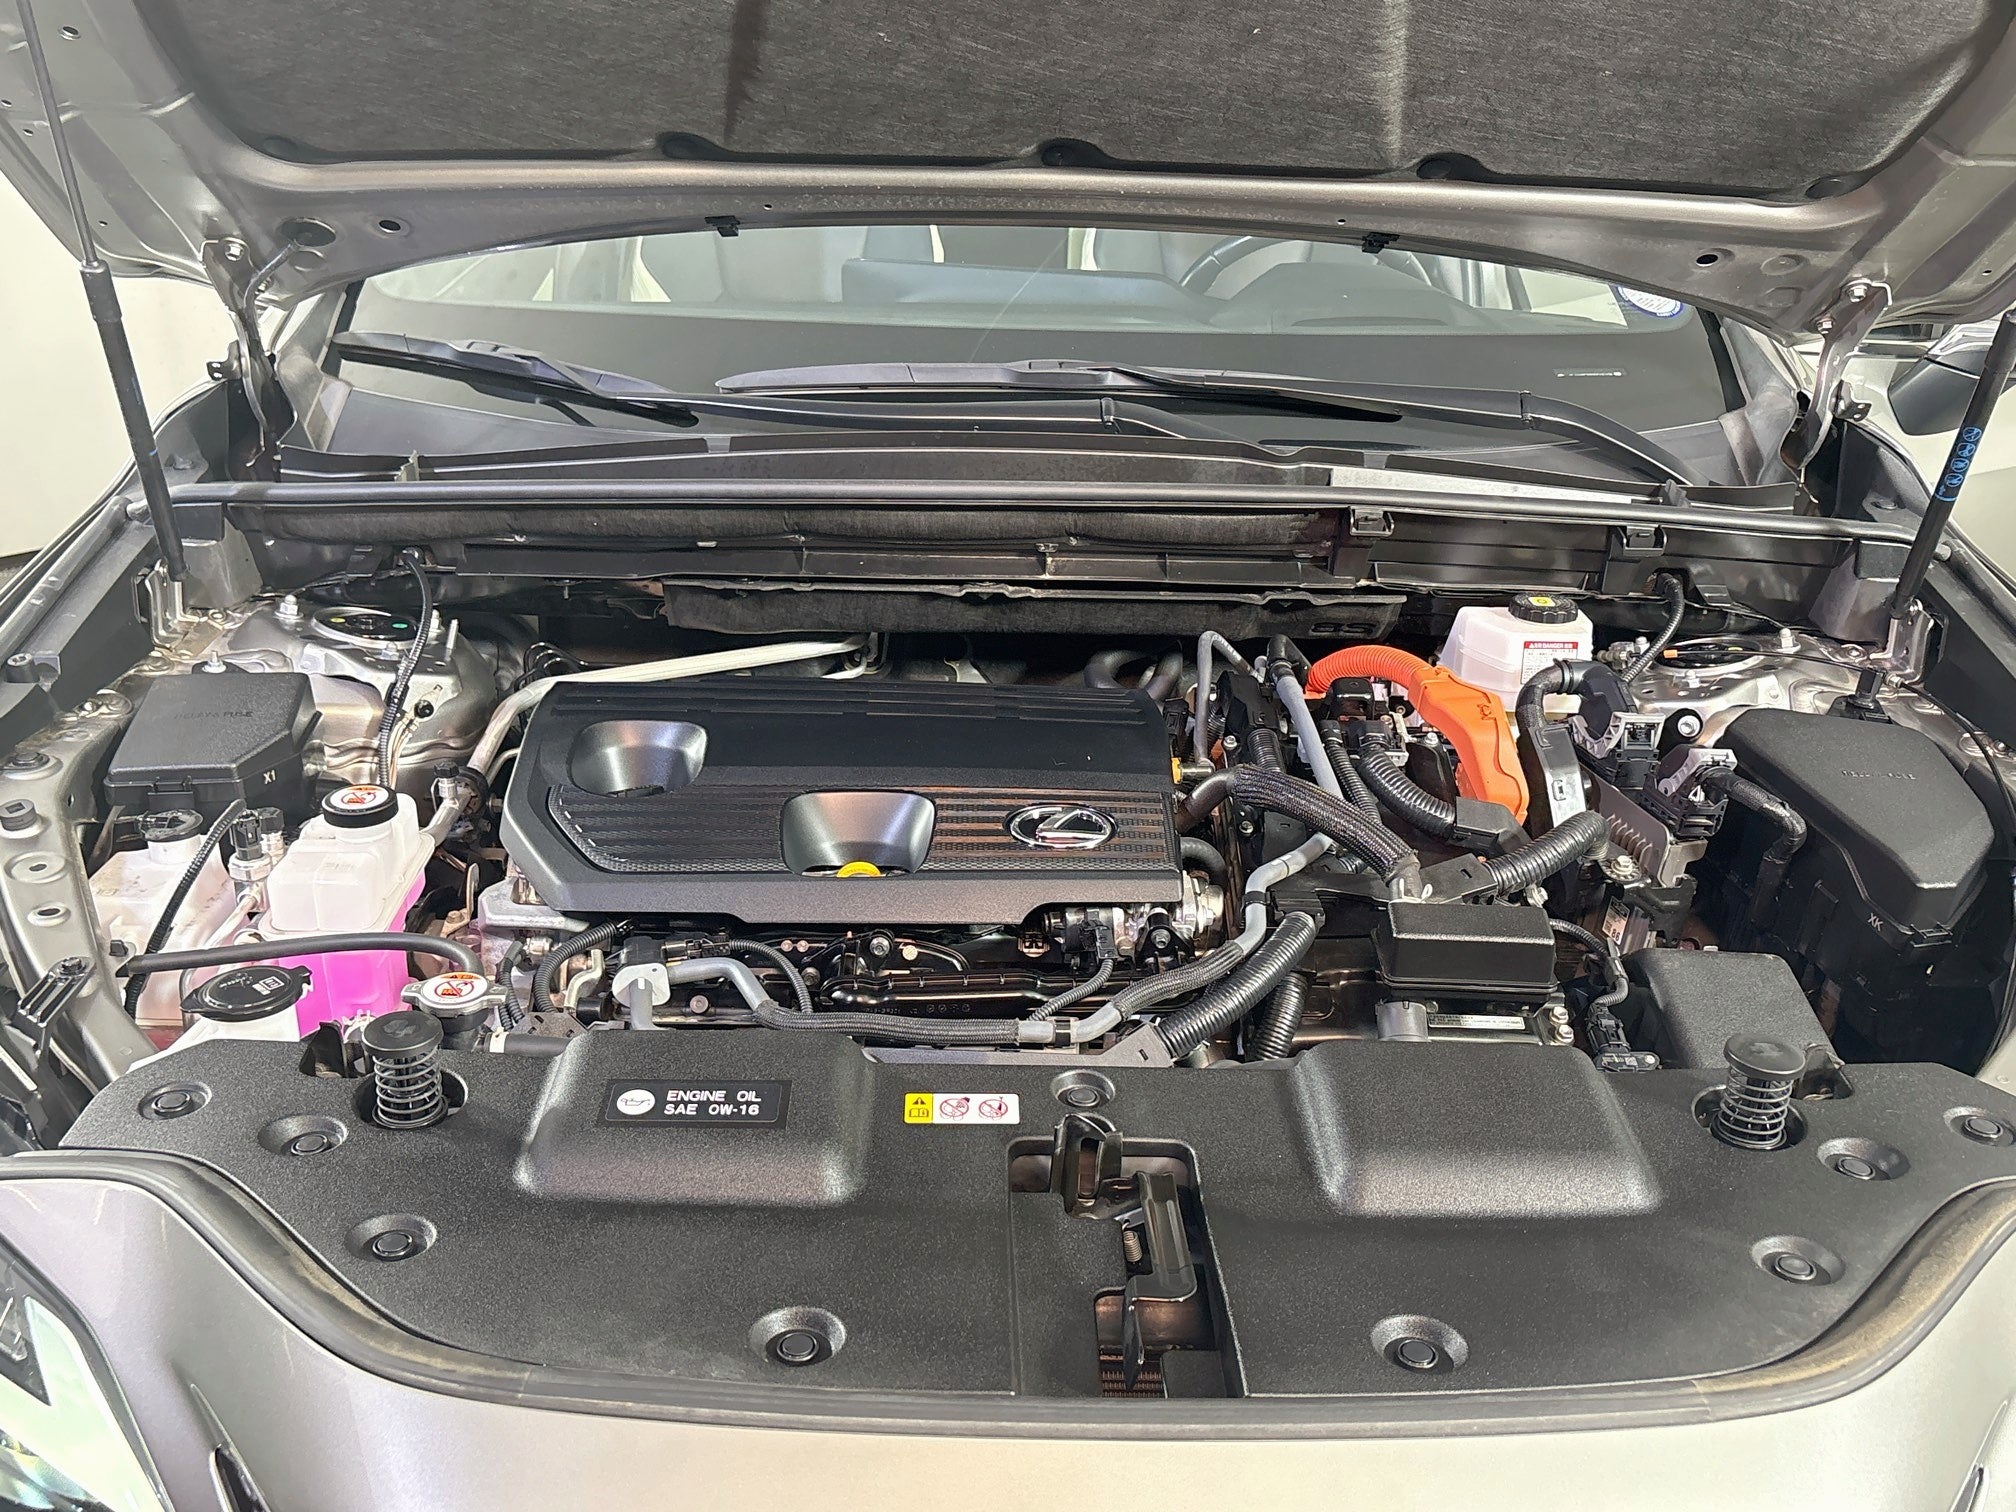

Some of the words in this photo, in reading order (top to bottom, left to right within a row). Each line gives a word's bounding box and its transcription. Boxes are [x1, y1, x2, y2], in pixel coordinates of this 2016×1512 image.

[263, 769, 276, 785] X1
[666, 1090, 727, 1102] ENGINE
[736, 1090, 762, 1102] OIL
[663, 1103, 698, 1115] SAE
[708, 1103, 760, 1115] 0W-16
